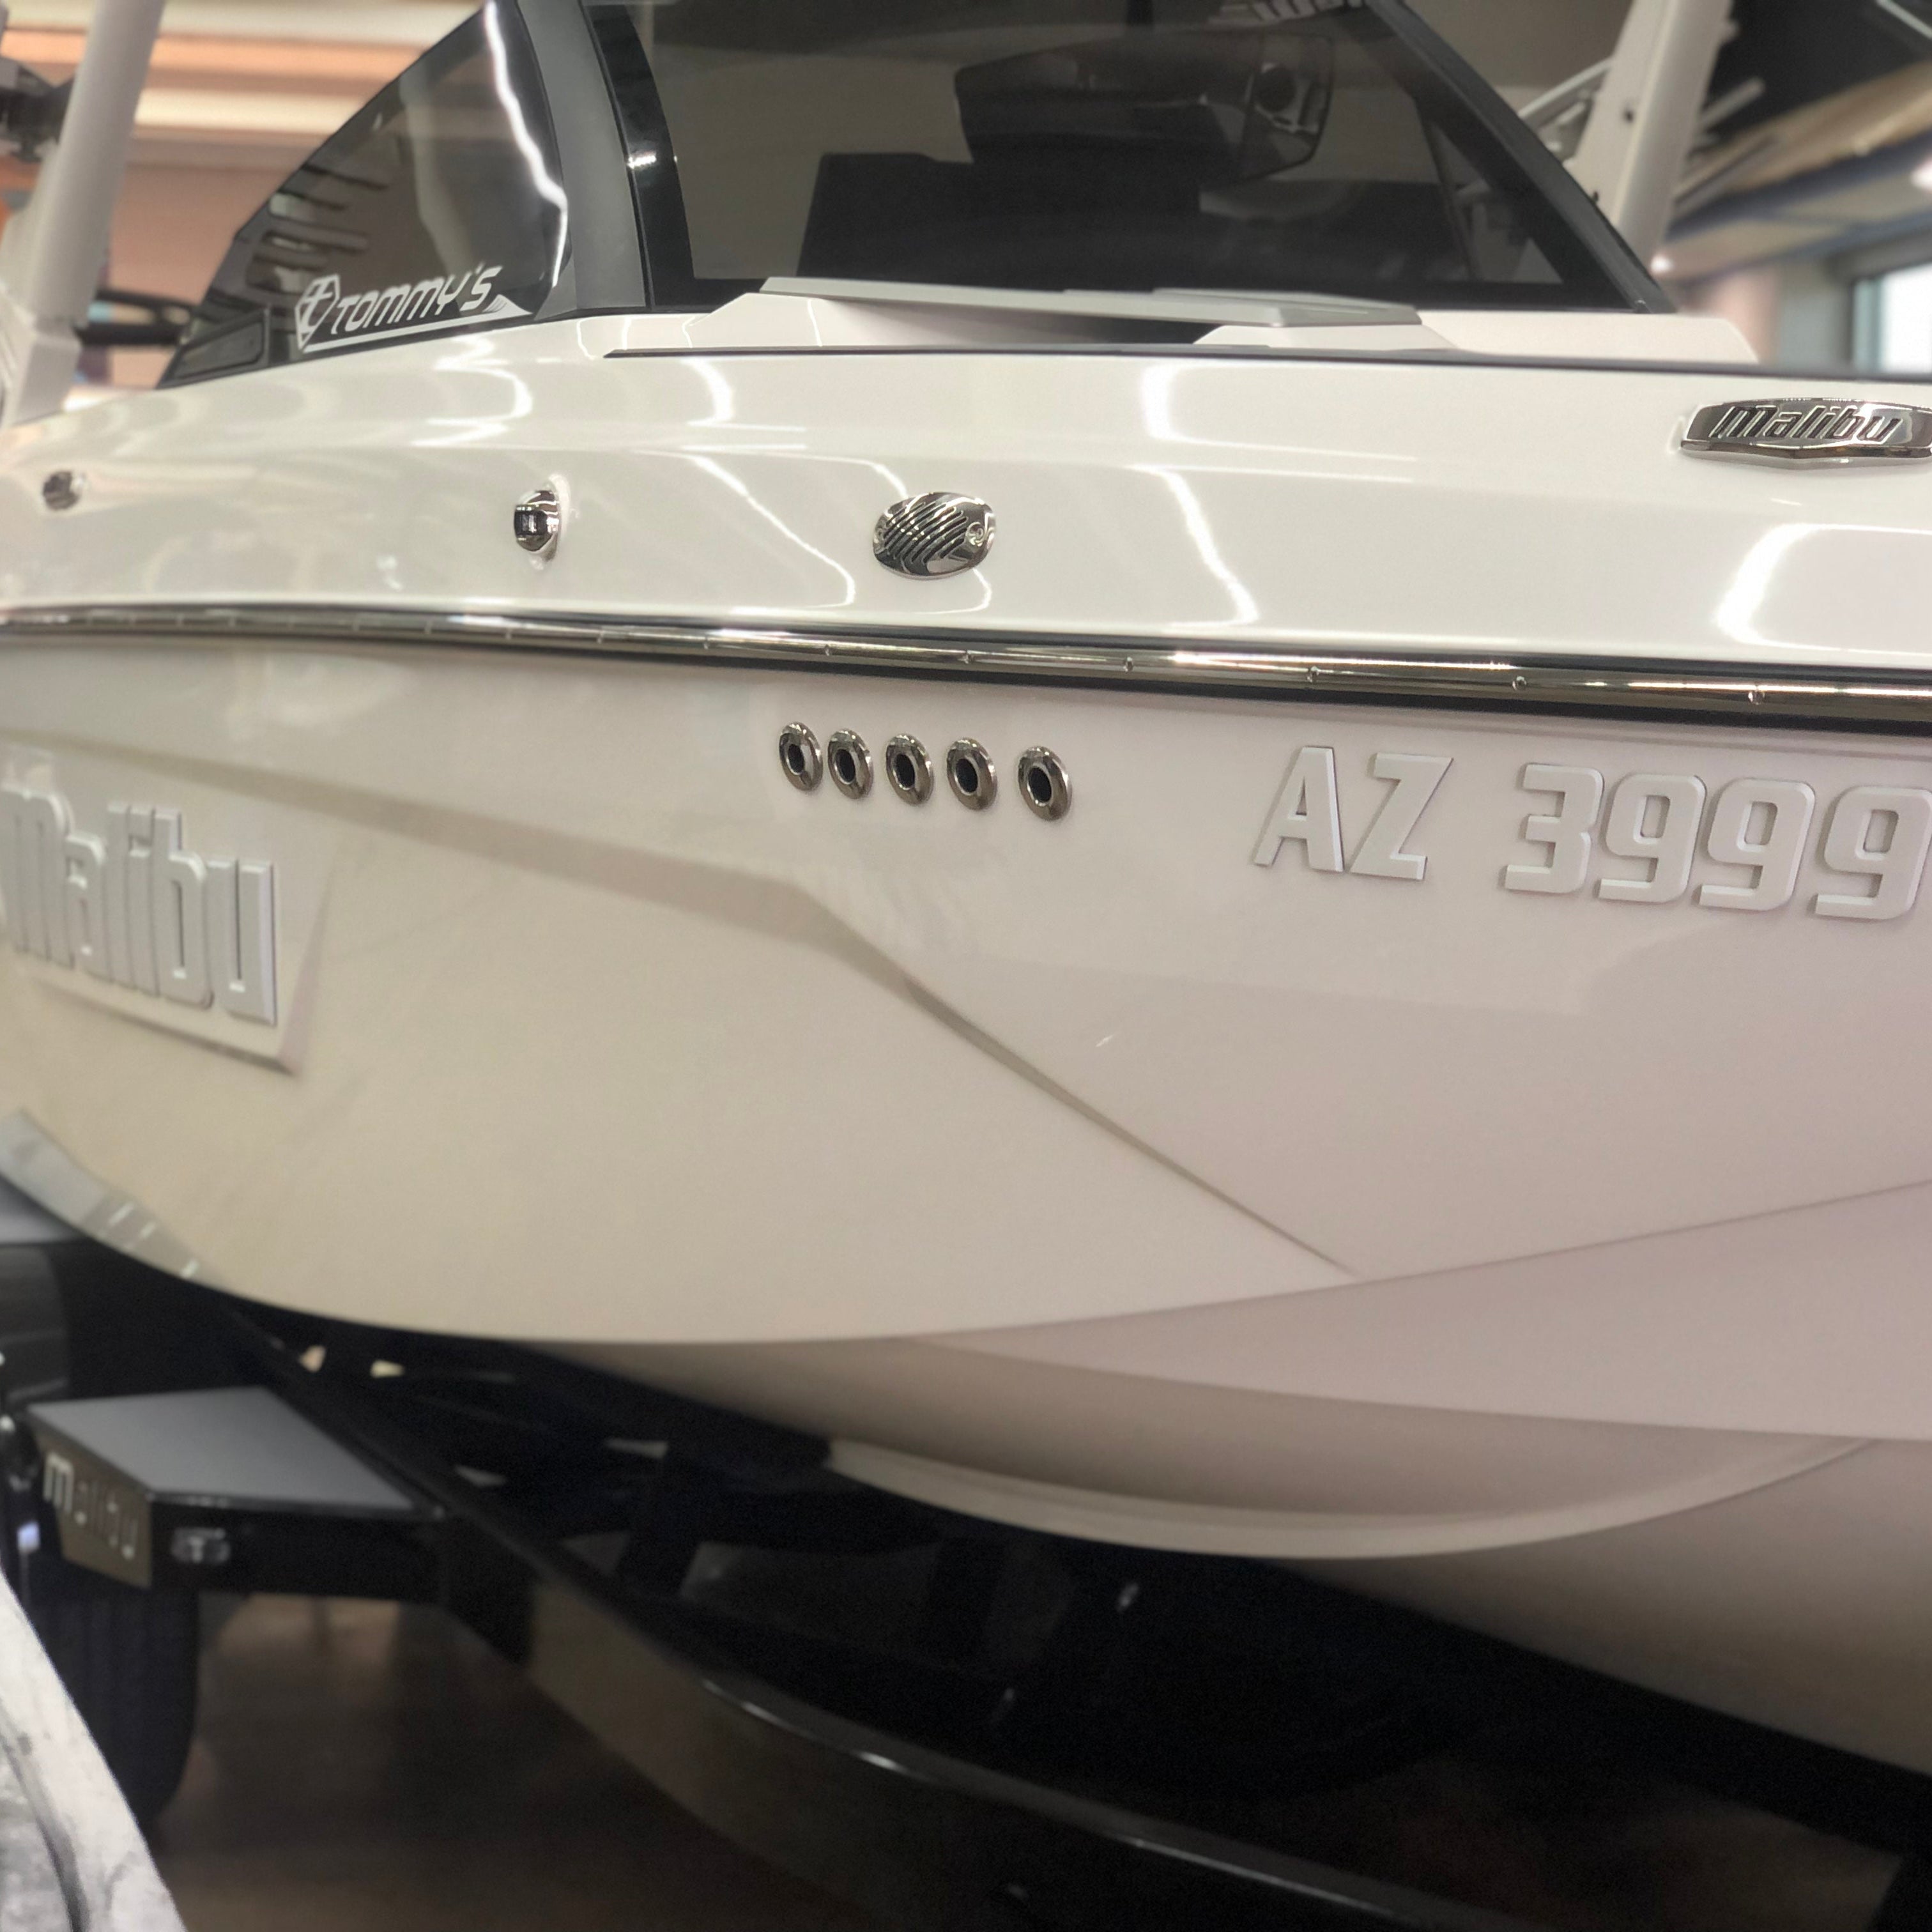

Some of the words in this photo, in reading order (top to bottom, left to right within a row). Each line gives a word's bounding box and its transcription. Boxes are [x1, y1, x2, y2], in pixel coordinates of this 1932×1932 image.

[331, 261, 503, 335] TOMMY'S
[1254, 746, 1454, 880] AZ
[1504, 763, 1932, 920] 3999
